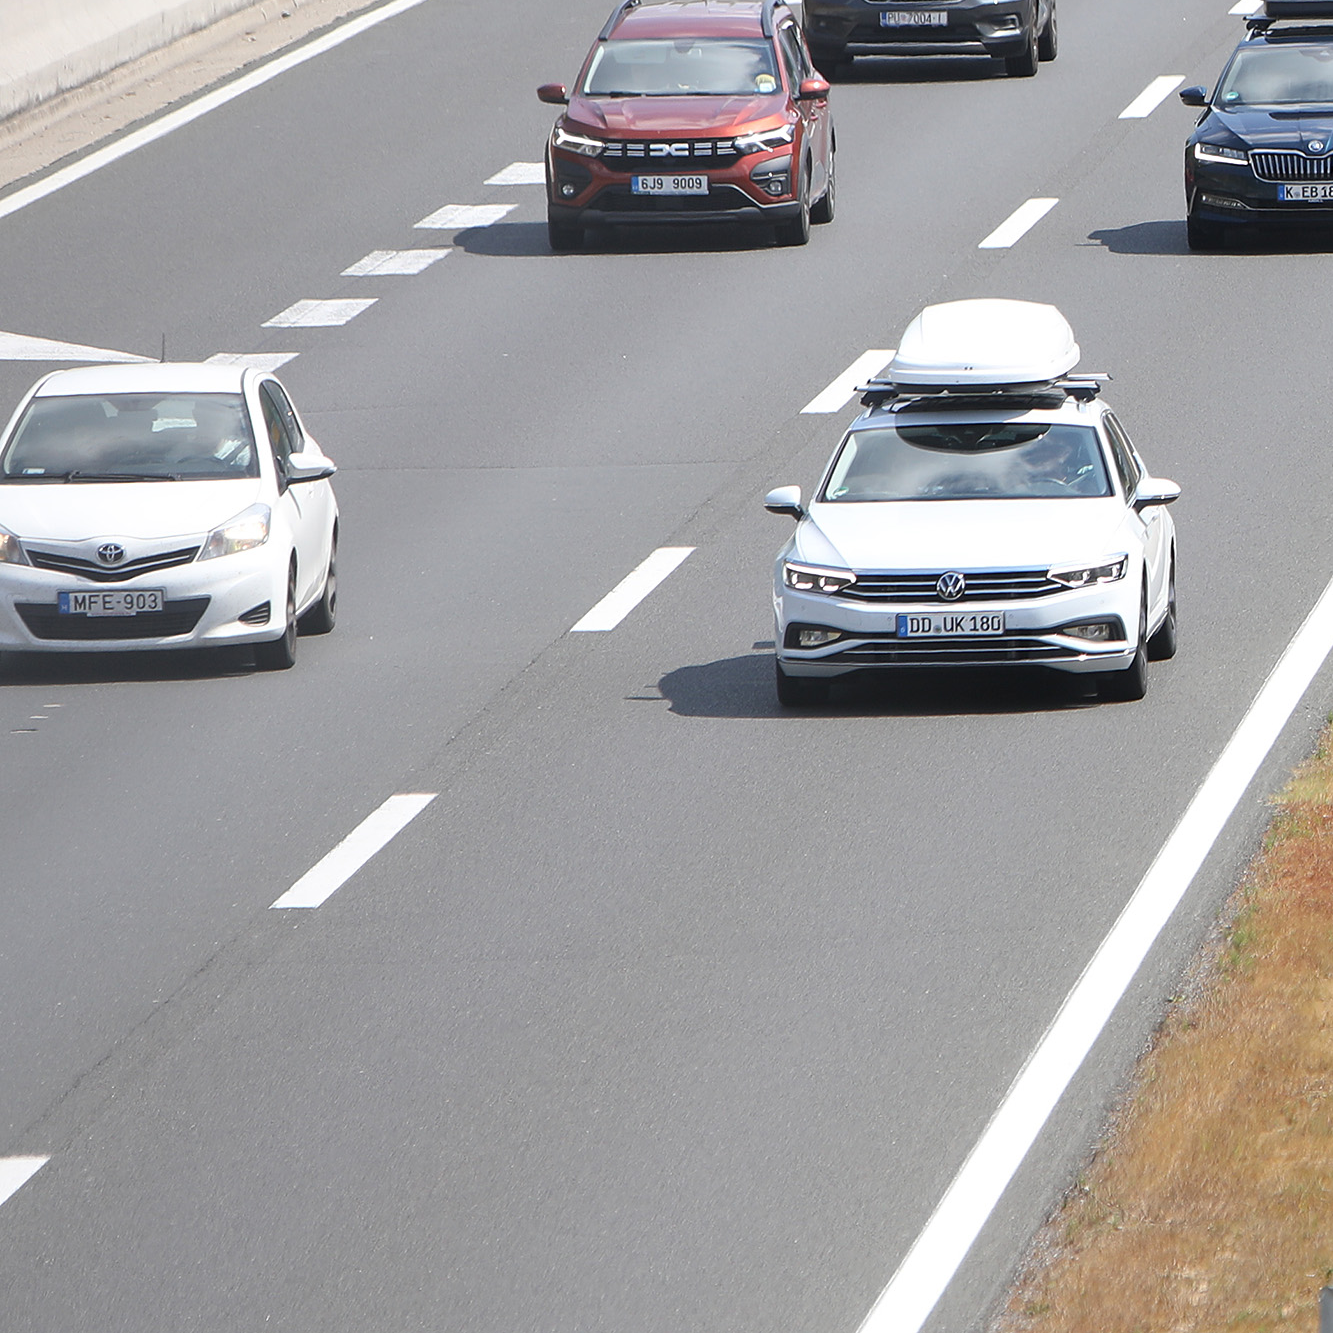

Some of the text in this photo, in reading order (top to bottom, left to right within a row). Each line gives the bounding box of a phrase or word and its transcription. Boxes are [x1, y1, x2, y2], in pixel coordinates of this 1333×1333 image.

[641, 177, 702, 190] 6J9 9009
[1286, 186, 1293, 198] K
[1302, 186, 1318, 198] EB
[74, 593, 158, 611] MFE-903
[910, 615, 1001, 633] DD UK 180
